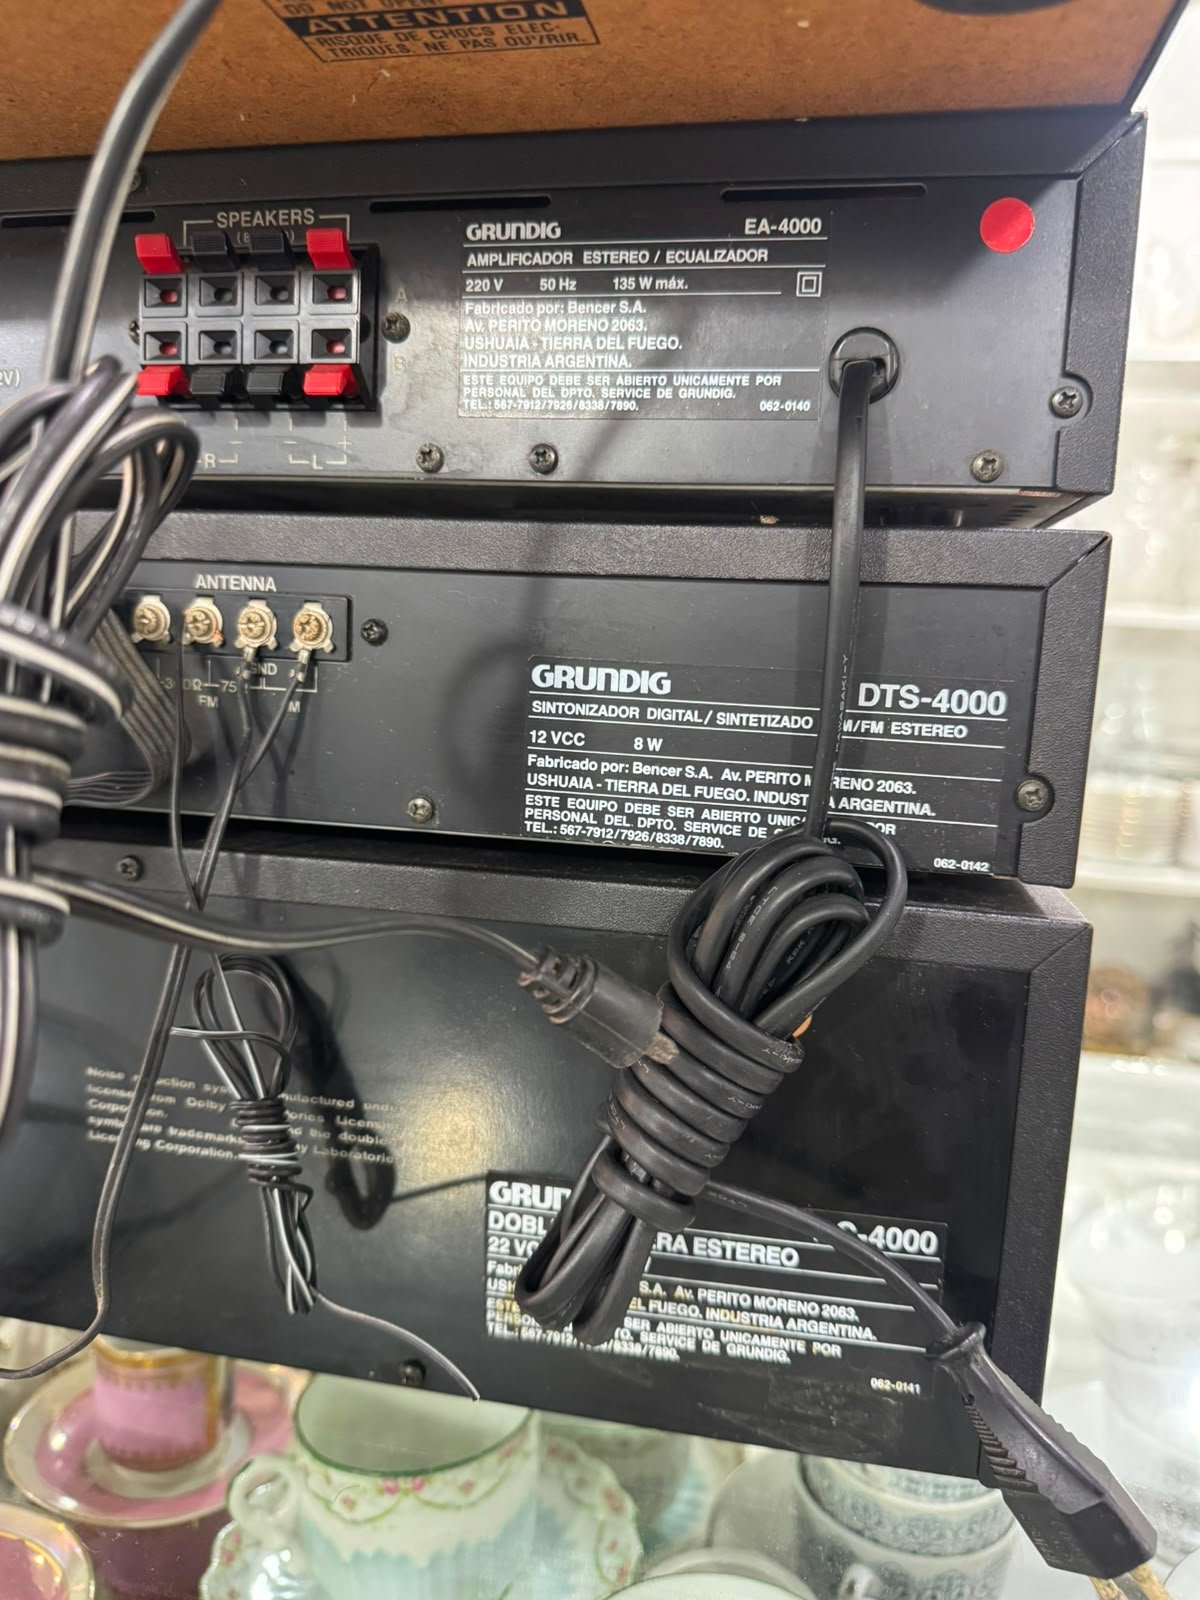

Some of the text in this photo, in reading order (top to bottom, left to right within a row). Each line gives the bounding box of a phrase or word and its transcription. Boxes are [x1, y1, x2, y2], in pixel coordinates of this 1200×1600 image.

[308, 1, 568, 34] ATTENTION
[315, 33, 386, 47] RISQUE
[394, 30, 421, 42] DE
[429, 25, 496, 40] CHOCS
[422, 40, 453, 53] NE
[459, 36, 498, 49] PAS
[216, 208, 315, 228] SPEAKERS
[466, 217, 822, 241] GRUNDIG EA-4000
[466, 249, 769, 267] AMPLIFICADOR ESTEREO / ECUALIZADOR
[465, 275, 689, 292] 220 V 50 Hz 135 W máx.
[465, 300, 647, 317] Fabricado por: Bencer S.A.
[489, 319, 542, 332] PERITO
[544, 319, 609, 332] MORENO
[611, 319, 648, 332] 2063.
[464, 337, 530, 351] USHUAIA
[542, 337, 592, 350] TIERRA
[596, 337, 625, 350] DEL
[627, 336, 683, 350] FUEGO.
[463, 354, 633, 368] INDUSTRIA ARGENTINA.
[462, 375, 783, 387] ESTE EQUIPO DEBE SER ABIERTO UNICAMENTE POR
[462, 387, 737, 399] PERSONAL DEL DPTO. SERVICE DE GRUNDIG.
[759, 400, 812, 412] 062-0140
[312, 454, 324, 470] L
[195, 573, 277, 592] ANTENNA
[531, 663, 1008, 716] GRUNDIG DTS-4000
[199, 694, 219, 708] FM
[531, 700, 640, 720] SINTONIZADOR
[842, 719, 884, 735] M/FM
[890, 721, 968, 739] ESTEREO
[529, 729, 663, 752] 12 VCC 8 W
[527, 753, 598, 772] Fabricado
[600, 761, 629, 775] por:
[632, 762, 683, 778] Bencer
[684, 765, 713, 780] S.A.
[720, 768, 742, 782] Av.
[745, 770, 802, 787] PERITO
[804, 773, 875, 792] MRENO
[876, 779, 917, 795] 2063.
[526, 772, 594, 790] USHUAIA
[604, 778, 659, 795] TIERRA
[661, 784, 692, 798] DEL
[694, 785, 751, 802] FUEGO.
[753, 789, 836, 810] INDUSTA
[837, 796, 937, 817] ARGENTINA.
[525, 794, 560, 809] ESTE
[566, 797, 619, 814] EQUIPO
[624, 802, 661, 817] DEBE
[667, 806, 695, 820] SER
[701, 808, 762, 825] ABIERTO
[524, 807, 598, 826] PERSONAL
[604, 814, 630, 828] DEL
[637, 816, 677, 832] DPTO.
[683, 820, 742, 837] SERVICE
[748, 825, 768, 839] DE
[559, 825, 725, 849] 567-7912/7926/8338/7890.
[933, 857, 991, 873] 062-0142
[185, 1095, 227, 1113] Dolby
[487, 1236, 511, 1255] 22
[693, 1235, 801, 1268] ESTEREO
[697, 1287, 750, 1308] PERITO
[753, 1292, 821, 1317] MORENO
[821, 1303, 860, 1323] 2063.
[648, 1299, 704, 1320] FUEGO.
[705, 1306, 785, 1331] INDUSTRIA
[786, 1317, 878, 1342] ARGENTINA.
[623, 1315, 651, 1332] SER
[655, 1320, 716, 1342] ABIERTO
[719, 1329, 807, 1355] UNICAMENTE
[812, 1340, 843, 1360] POR
[639, 1330, 697, 1353] SERVICE
[701, 1338, 721, 1355] DE
[726, 1342, 792, 1365] GRUNDIG.
[870, 1376, 921, 1395] 062-0141
